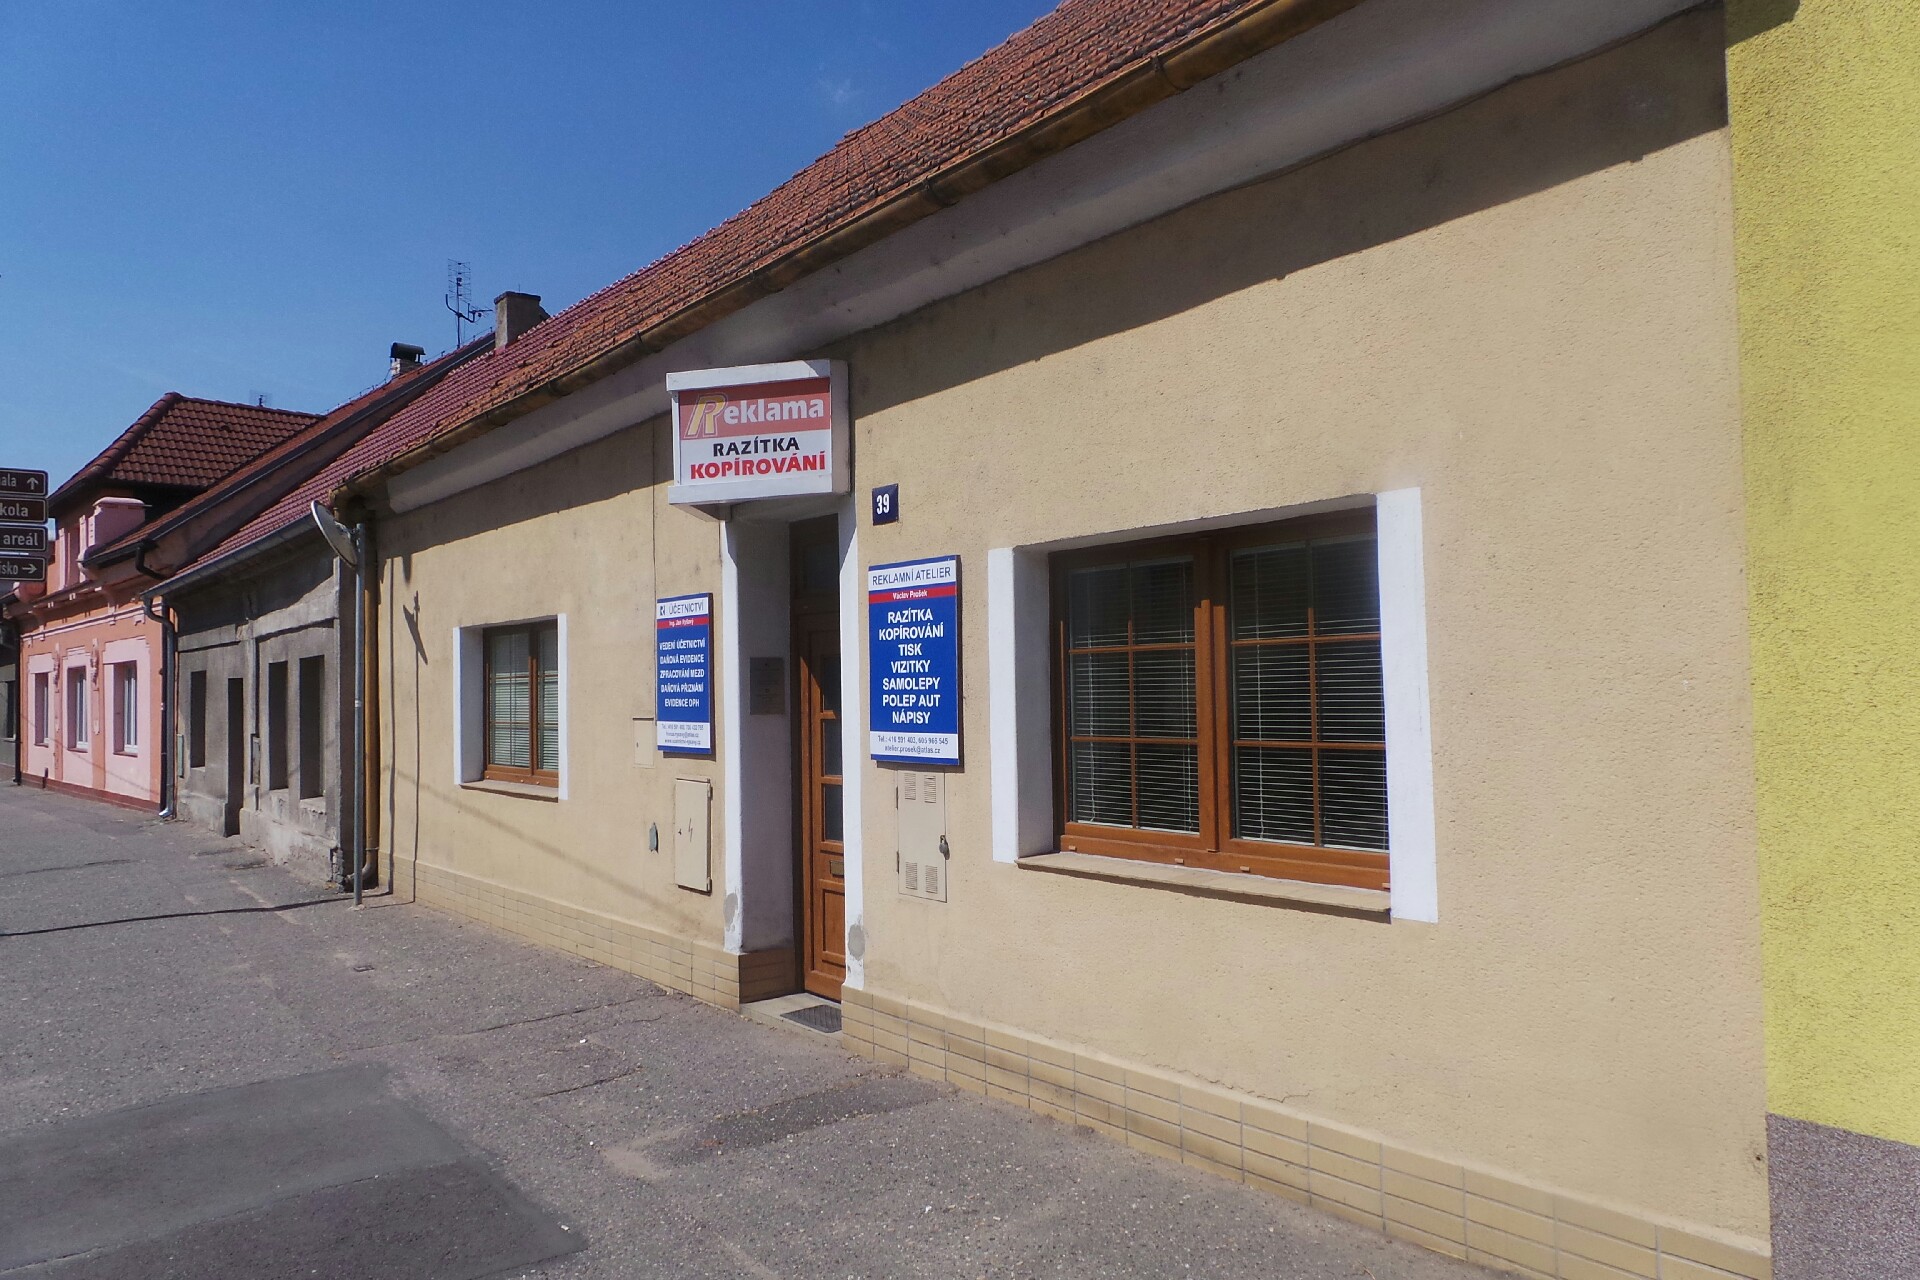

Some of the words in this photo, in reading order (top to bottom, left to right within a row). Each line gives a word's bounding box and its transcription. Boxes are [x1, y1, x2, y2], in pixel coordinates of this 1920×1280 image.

[684, 392, 824, 439] Reklama
[713, 436, 800, 457] RAZÍTKA
[690, 451, 826, 480] KOPÍROVÁNÍ
[876, 493, 890, 515] 39
[3, 532, 38, 546] areál
[872, 568, 914, 586] REKLAMNÍ
[915, 566, 951, 581] ATELIER
[669, 600, 704, 615] ÚČETNICTVÍ
[887, 607, 933, 624] RAZÍTKA
[879, 622, 944, 641] KOPÍROVÁNÍ
[659, 640, 675, 650] VEDENÍ
[676, 637, 706, 649] ÚČETNICTVÍ
[898, 643, 922, 656] TISK
[679, 654, 705, 664] EVIDENCE
[890, 659, 931, 674] VIZITKY
[659, 668, 690, 678] ZPRACOVÁNÍ
[690, 668, 705, 678] MEZD
[882, 677, 941, 690] SAMOLEPY
[664, 698, 688, 707] EVIDENCE
[882, 694, 917, 707] POLEP
[918, 694, 941, 707] AUT
[892, 709, 931, 724] NÁPISY
[938, 737, 949, 745] 545
